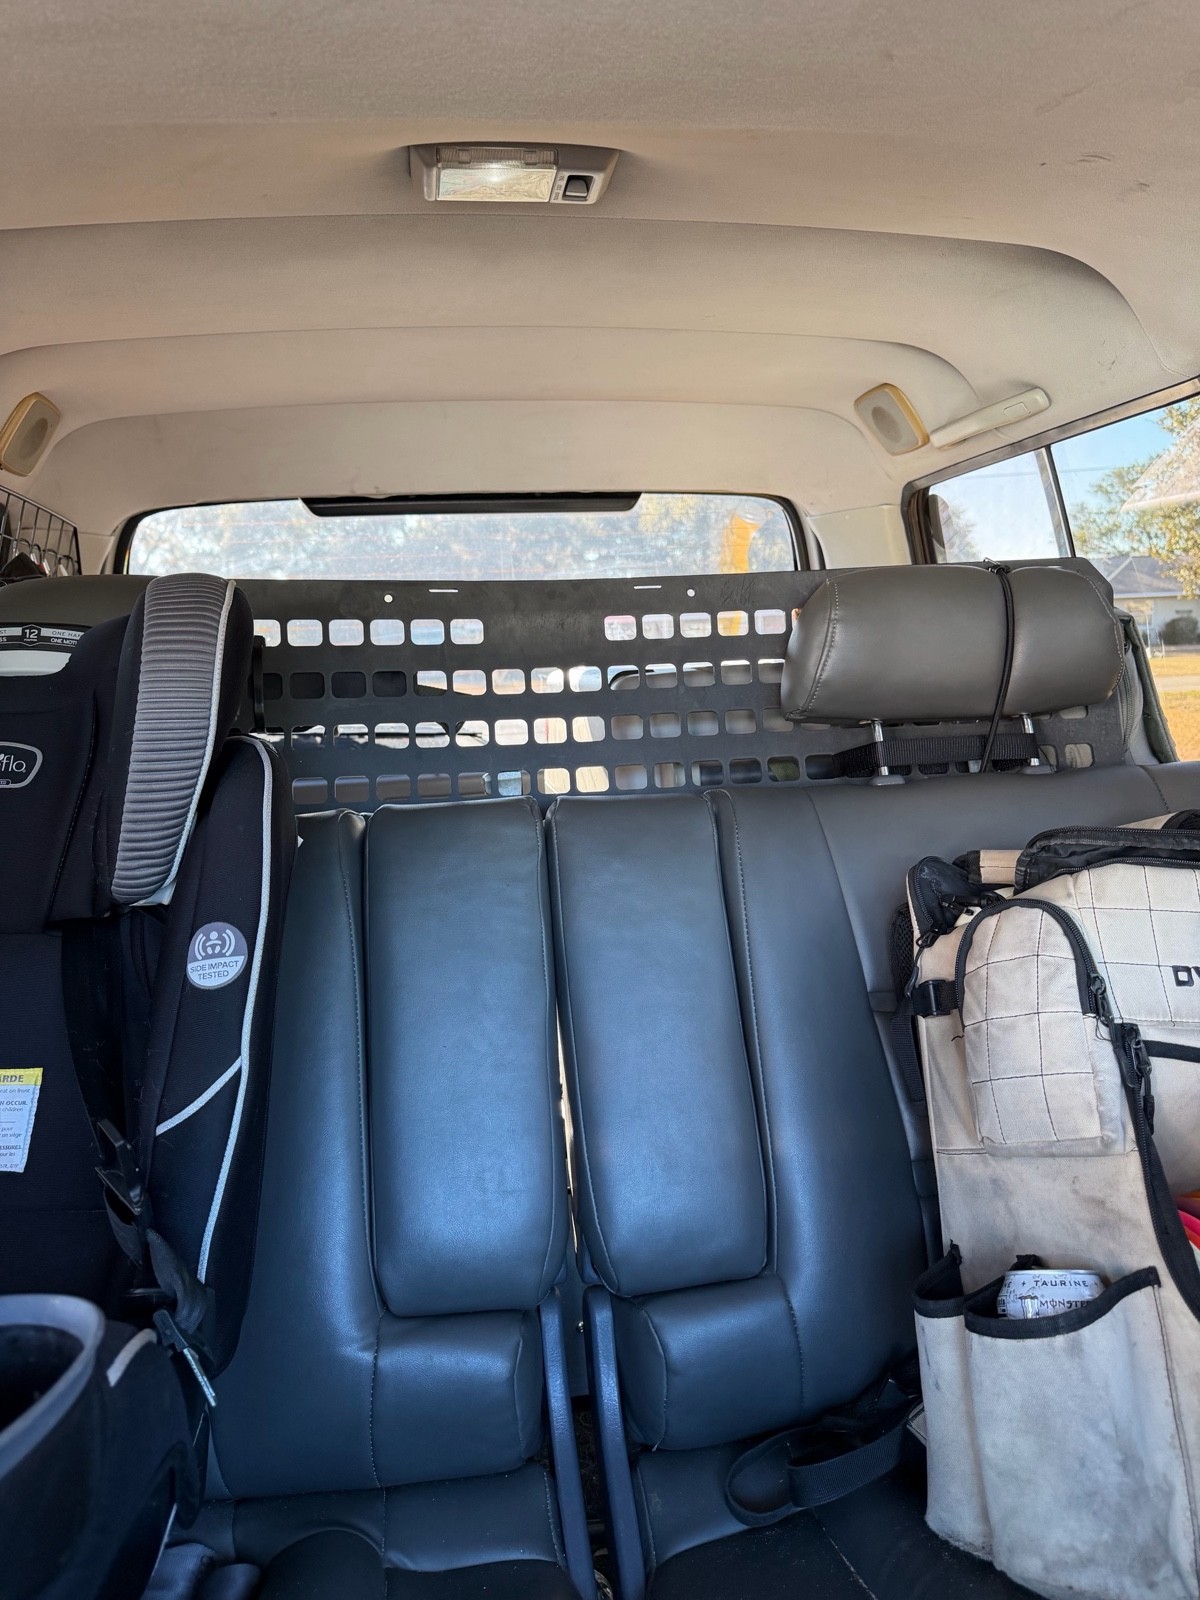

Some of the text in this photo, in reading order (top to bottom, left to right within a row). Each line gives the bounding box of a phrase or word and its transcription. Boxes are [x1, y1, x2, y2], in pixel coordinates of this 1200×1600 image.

[25, 629, 38, 639] 12
[0, 754, 26, 772] flo
[190, 960, 240, 973] SIDE IMPACT
[197, 969, 230, 980] TESTED
[0, 1074, 24, 1083] RDE
